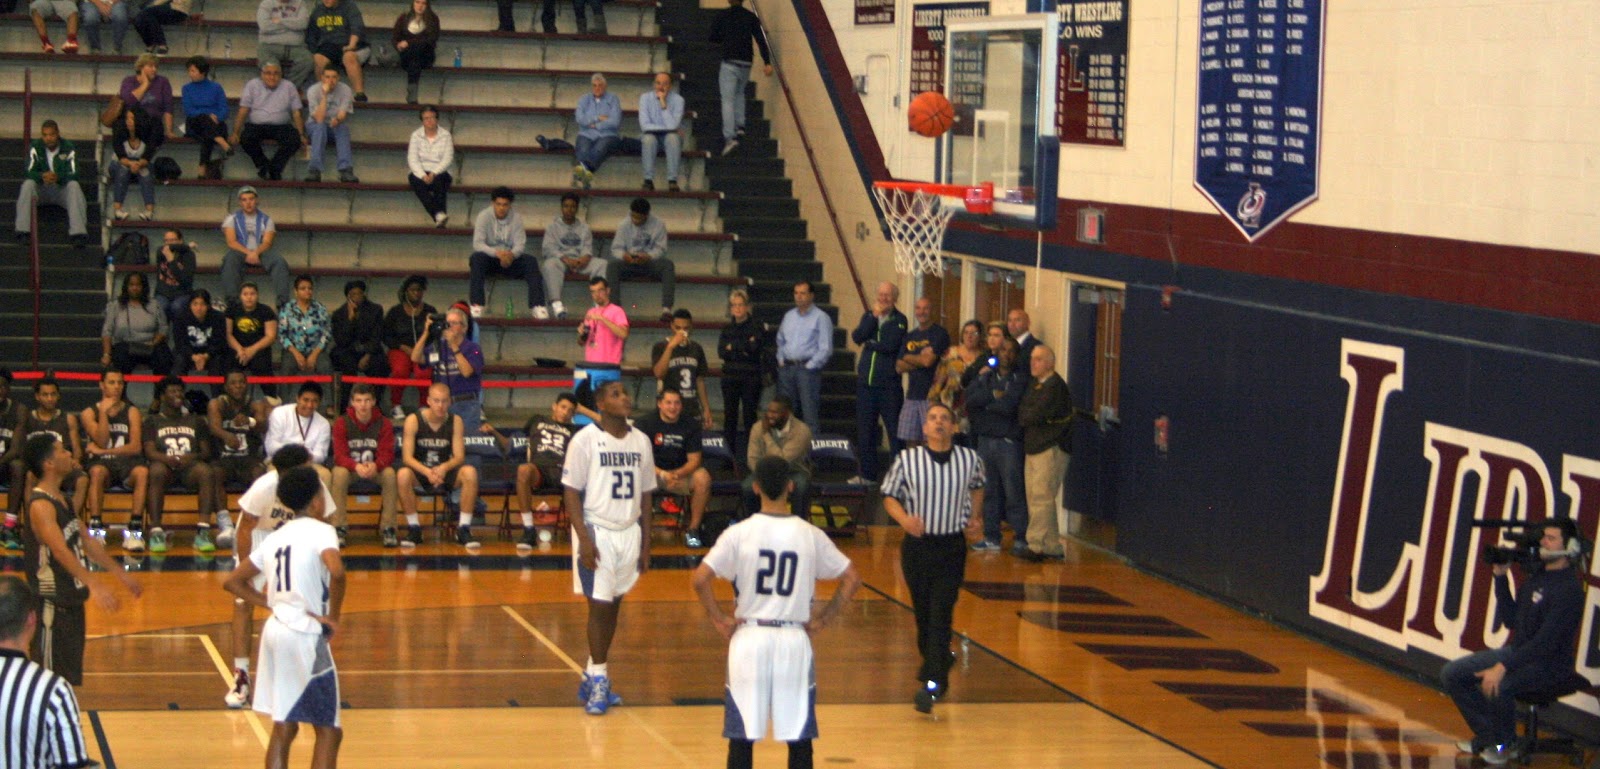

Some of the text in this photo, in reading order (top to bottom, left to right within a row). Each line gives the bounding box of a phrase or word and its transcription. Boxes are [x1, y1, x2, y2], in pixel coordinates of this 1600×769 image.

[1075, 2, 1122, 22] WRESTLING
[1075, 25, 1103, 38] WINS
[680, 368, 692, 389] 3
[464, 436, 495, 447] BERTY
[702, 438, 723, 447] ERTY
[811, 439, 849, 450] LIBERTY
[612, 470, 635, 499] 23
[275, 545, 292, 592] 11
[756, 549, 798, 596] 20
